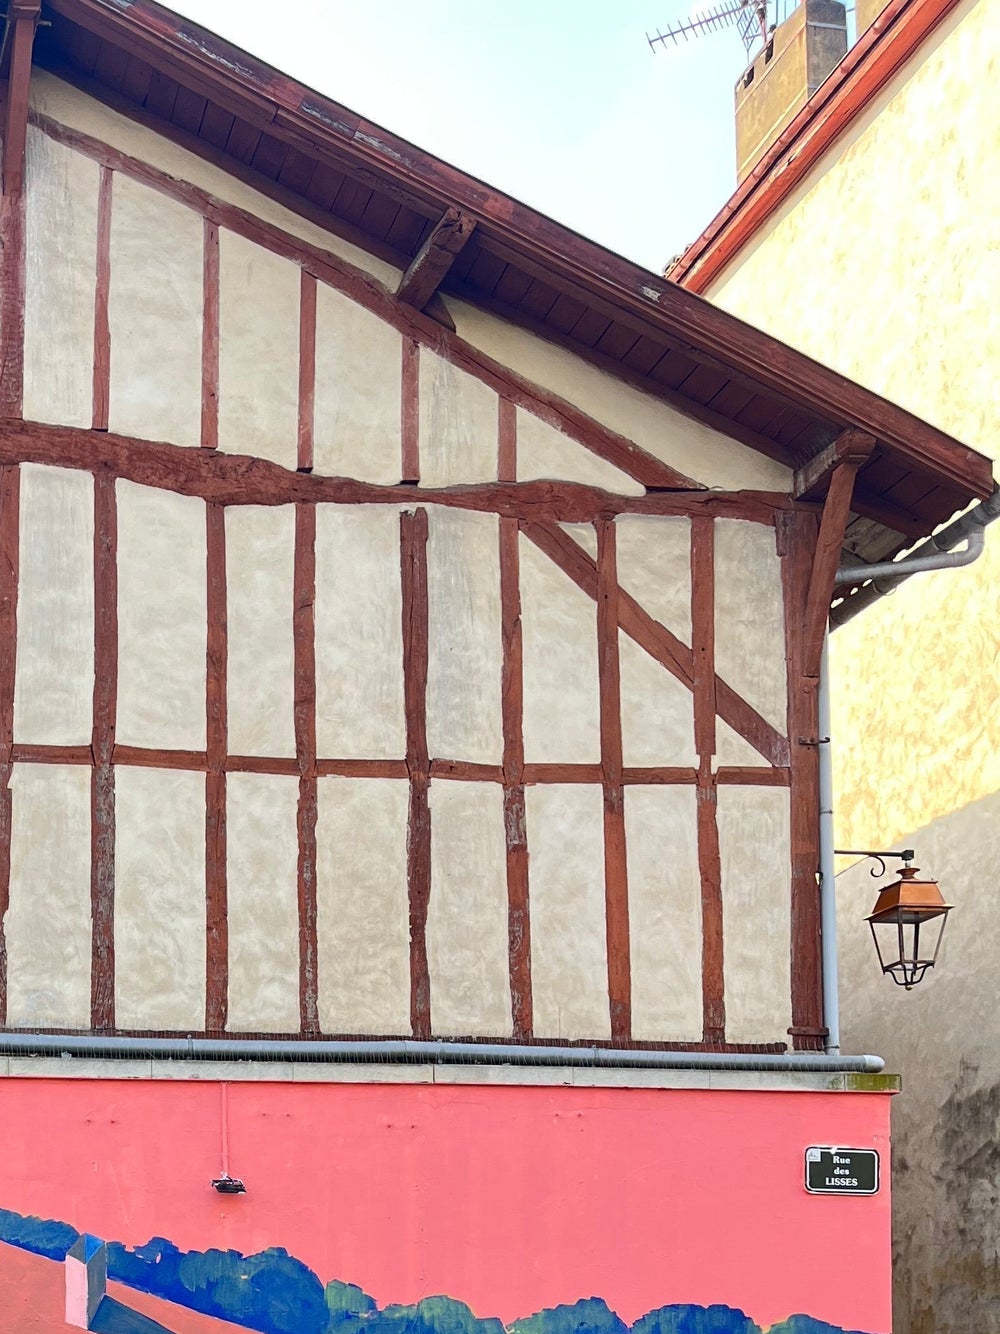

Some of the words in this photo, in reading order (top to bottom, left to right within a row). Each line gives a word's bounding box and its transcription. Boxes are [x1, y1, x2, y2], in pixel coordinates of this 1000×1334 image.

[833, 1155, 850, 1164] Rue
[833, 1167, 849, 1175] des
[825, 1177, 858, 1186] LISSES
